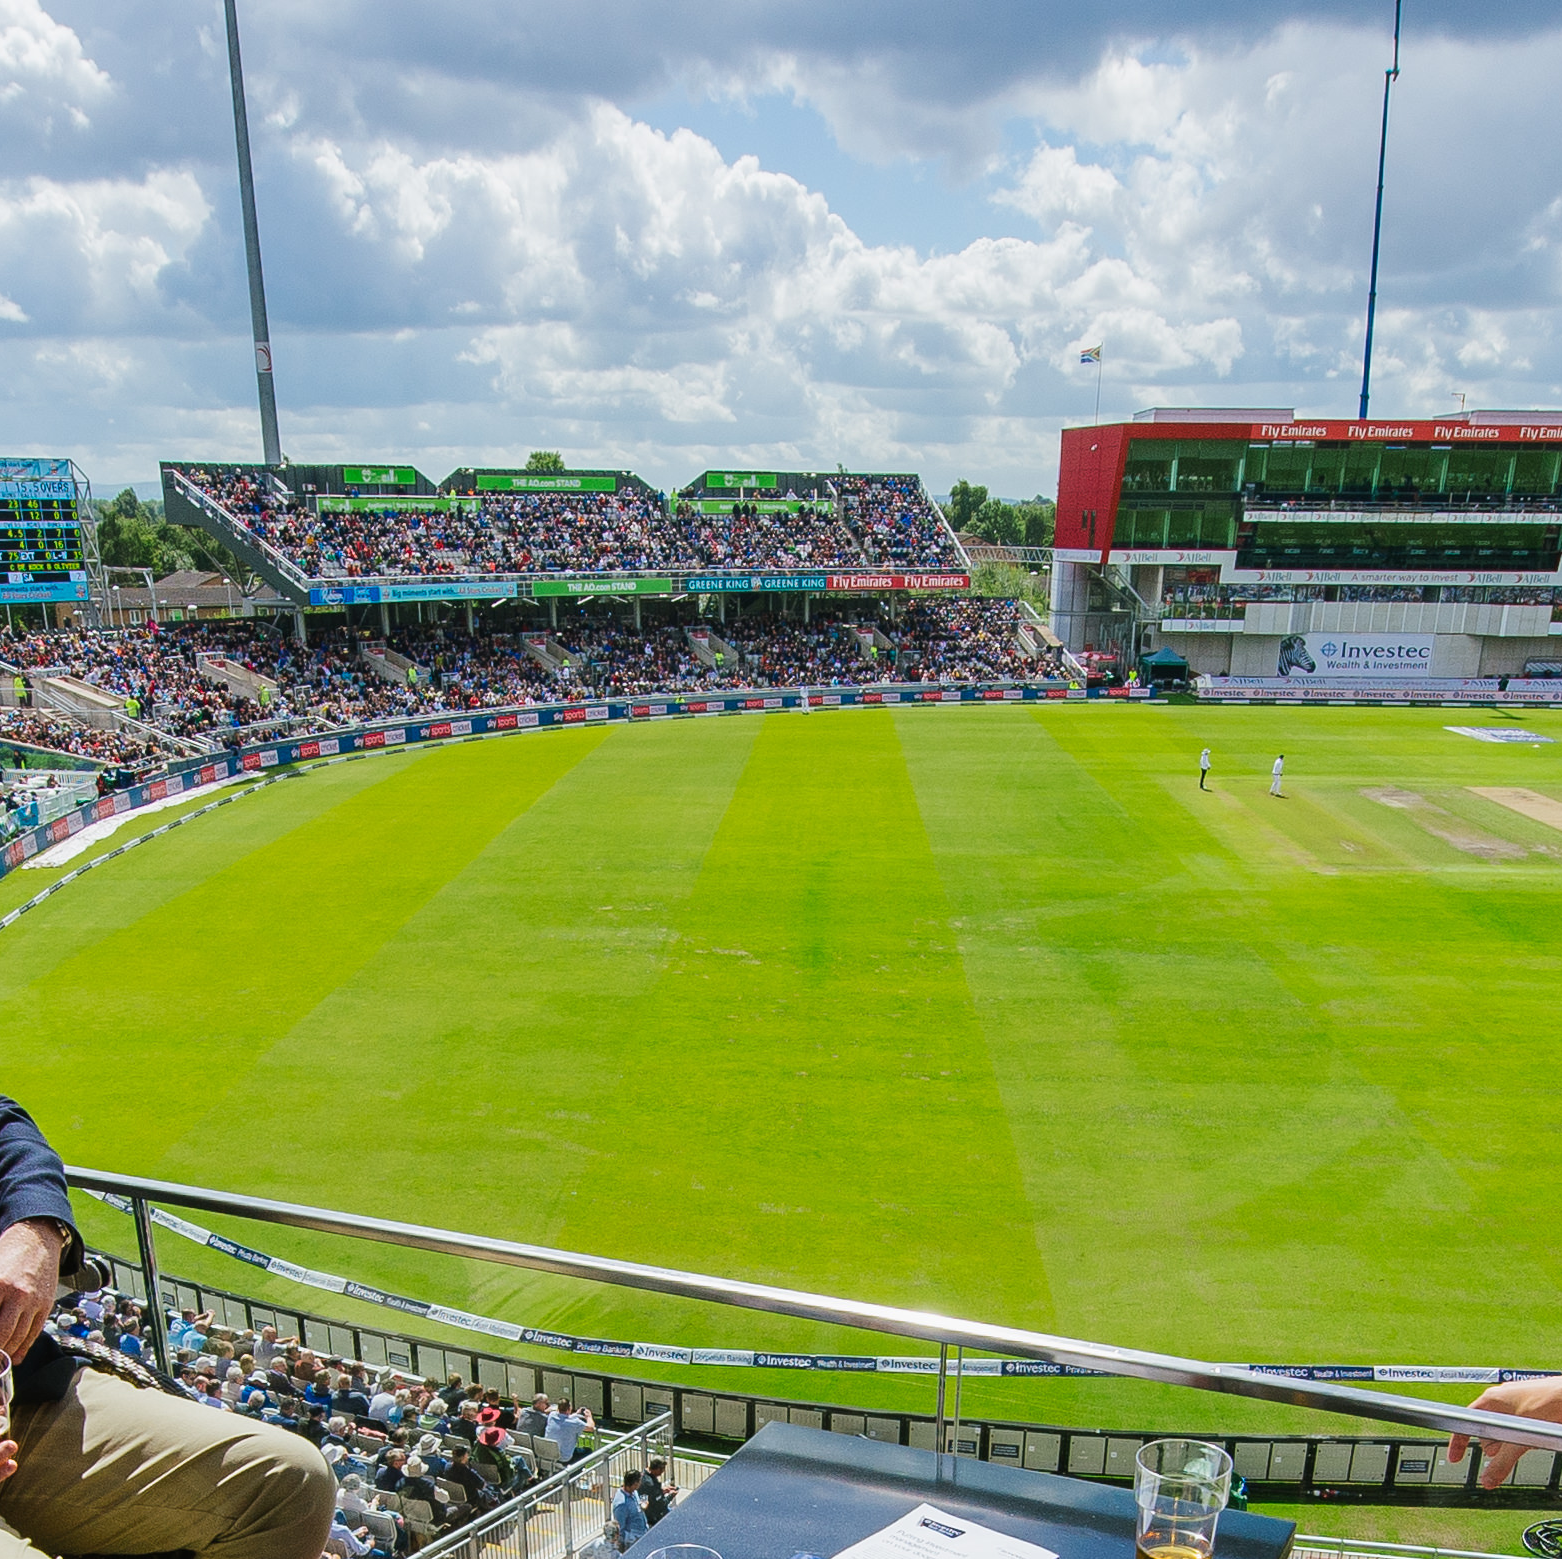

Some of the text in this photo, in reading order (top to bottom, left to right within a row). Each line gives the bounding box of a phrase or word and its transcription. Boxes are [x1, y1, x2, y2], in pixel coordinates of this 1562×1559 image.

[1261, 425, 1326, 437] Fly Emirates
[1348, 426, 1413, 438] Fly Emirates
[1435, 426, 1499, 439] Fly Emirates
[1520, 427, 1538, 439] Fly
[41, 482, 68, 492] OVERS
[512, 478, 581, 487] THE AO.com STAND
[20, 552, 34, 560] EXT
[24, 574, 34, 582] SA
[689, 578, 825, 589] GREENE KING GREENE KING
[833, 575, 892, 589] Fly Emirates
[904, 575, 963, 589] Fly Emirates
[1265, 572, 1291, 582] AJBell
[1431, 574, 1459, 582] invest
[1476, 574, 1502, 583] AJBell
[1523, 574, 1549, 584] AJBell
[567, 582, 636, 592] THE AO.com STAND
[1341, 642, 1430, 658] Investec
[1327, 661, 1428, 669] Wealth & Investment
[1211, 689, 1246, 697] Investec
[1310, 690, 1345, 698] Investec
[1360, 691, 1395, 699] Investec
[1460, 692, 1495, 700] Investec
[1511, 692, 1545, 700] Investec
[564, 708, 607, 722] sports cricket
[497, 715, 537, 729] sports cricket
[431, 723, 470, 738] sports cricket
[355, 1286, 384, 1303] Investec
[440, 1310, 472, 1326] Investec
[534, 1331, 630, 1356] Investec Private Banking
[645, 1346, 687, 1360] Investec
[767, 1354, 812, 1367] Investec
[891, 1359, 936, 1370] Investec
[1016, 1362, 1061, 1374] Investec
[1389, 1367, 1434, 1379] Investec
